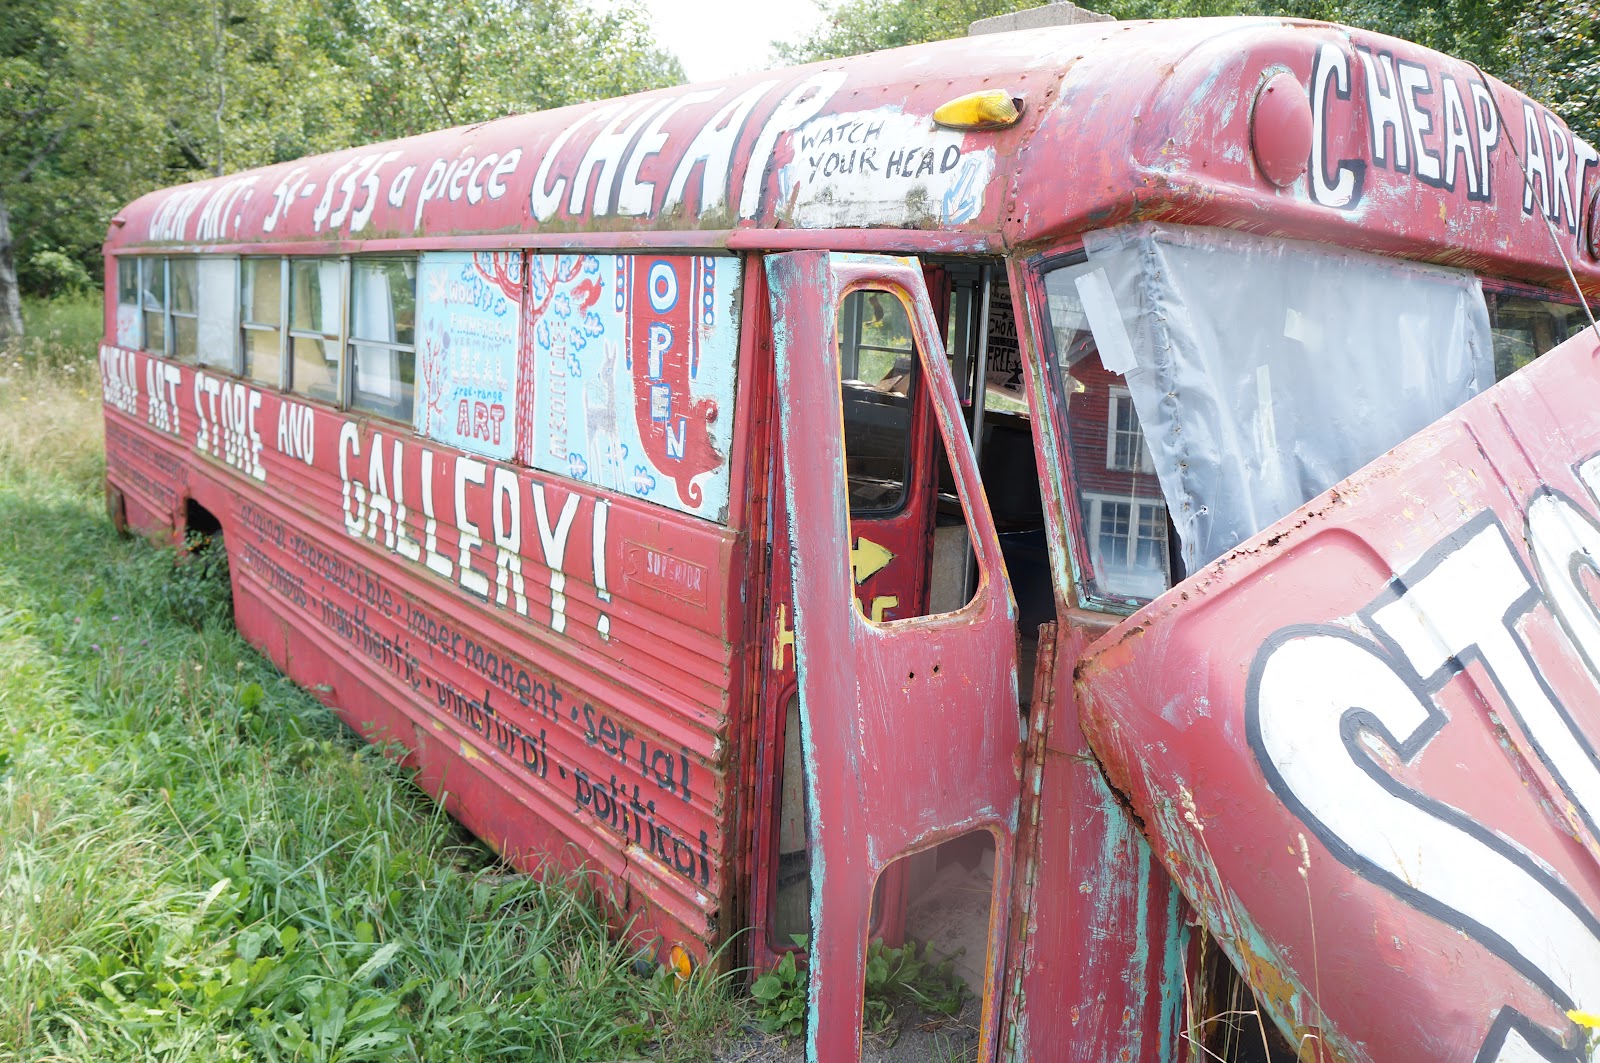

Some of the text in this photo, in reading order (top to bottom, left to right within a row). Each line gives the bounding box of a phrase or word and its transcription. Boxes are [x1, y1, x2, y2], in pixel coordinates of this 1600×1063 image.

[388, 164, 418, 208] a
[413, 144, 524, 231] piece
[530, 70, 849, 222] CHEAP
[801, 119, 886, 153] WATCH
[808, 143, 961, 184] YOUR HEAD
[1308, 43, 1599, 256] CHEAP ART
[146, 358, 181, 435] ART
[194, 371, 267, 482] STORE
[278, 401, 315, 466] AND
[450, 347, 509, 391] LOCAL
[456, 399, 506, 445] ART
[647, 259, 687, 460] OPEN
[241, 504, 692, 803] original reproducible impermanent serial
[320, 585, 422, 690] inauthentic
[435, 677, 548, 779] unnatural
[573, 767, 710, 888] political
